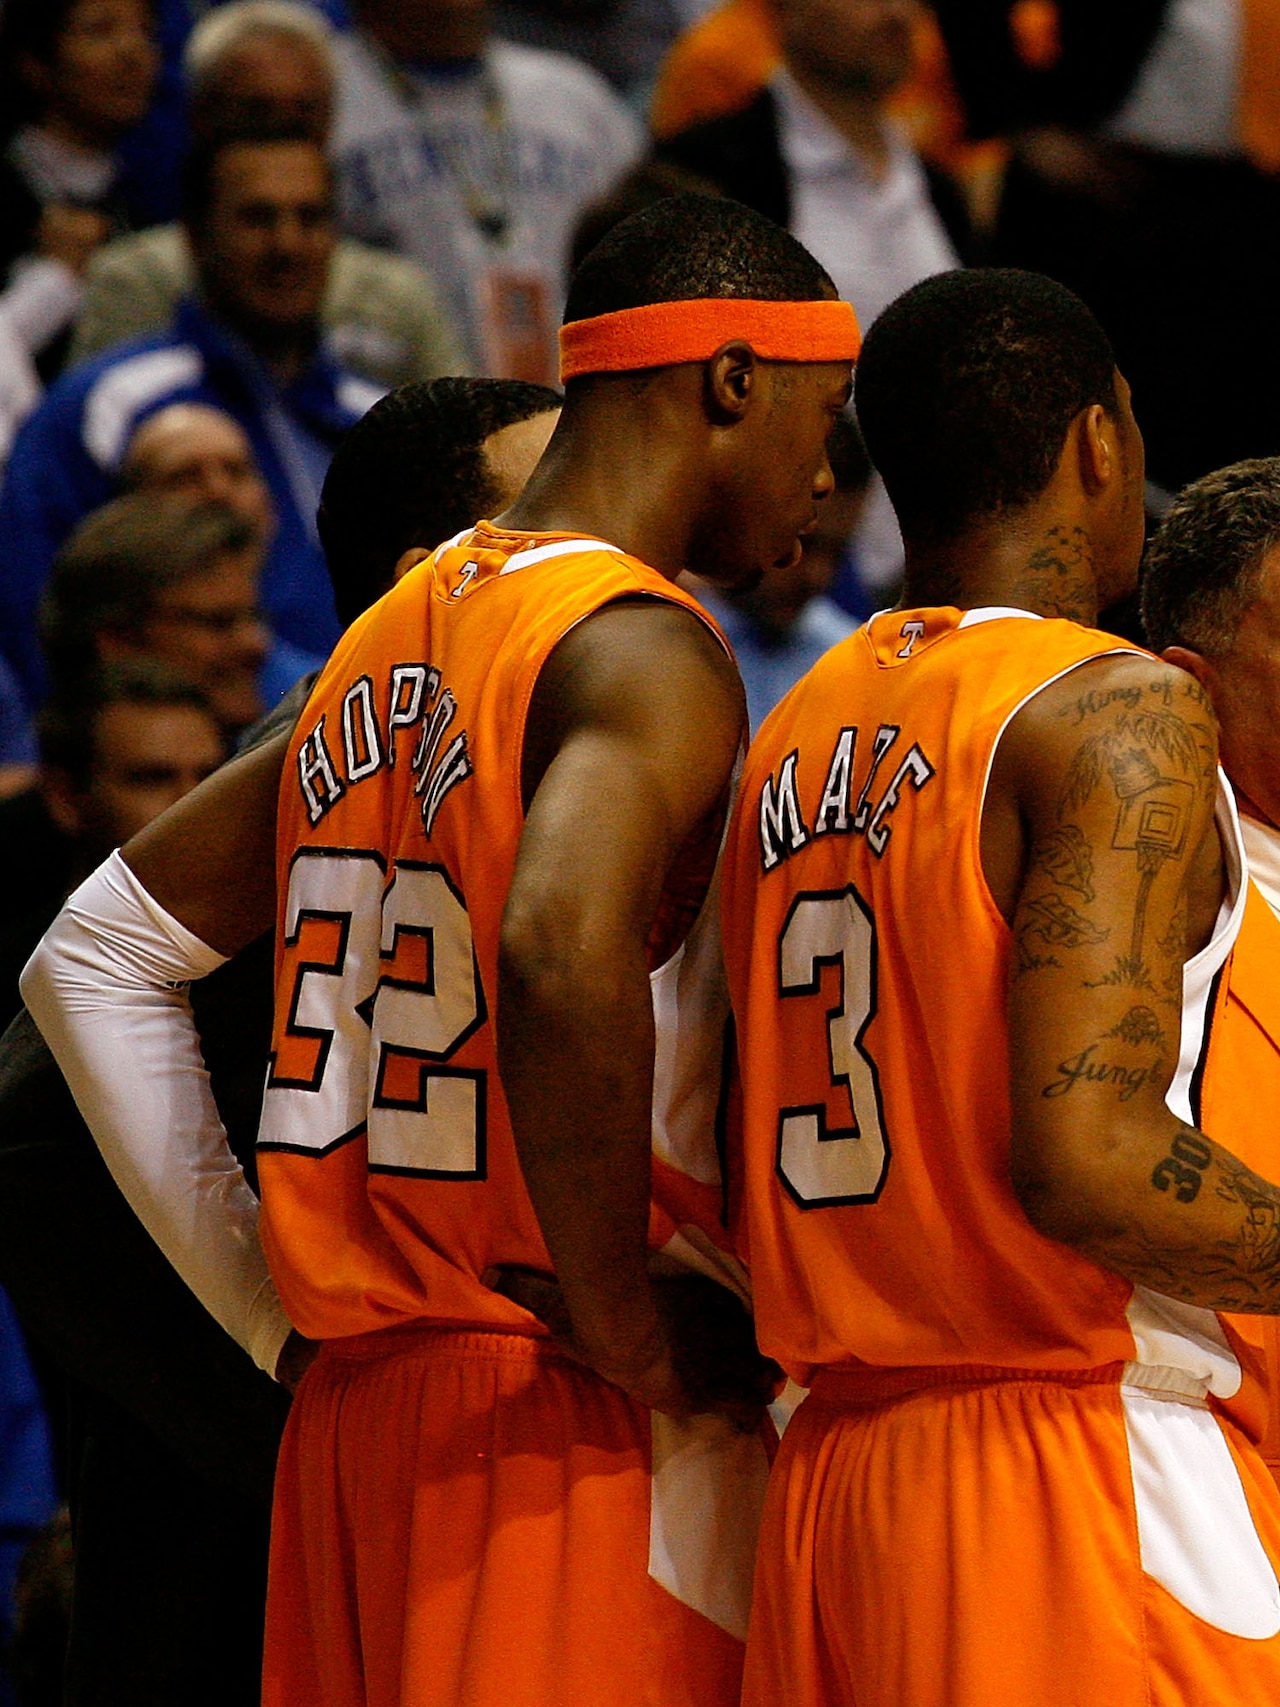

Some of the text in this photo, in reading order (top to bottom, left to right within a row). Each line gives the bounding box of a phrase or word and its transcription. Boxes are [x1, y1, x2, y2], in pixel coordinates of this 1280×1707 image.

[758, 723, 937, 875] MAZE
[254, 845, 488, 1182] 32
[775, 881, 892, 1211] 3
[1151, 1131, 1213, 1205] 30
